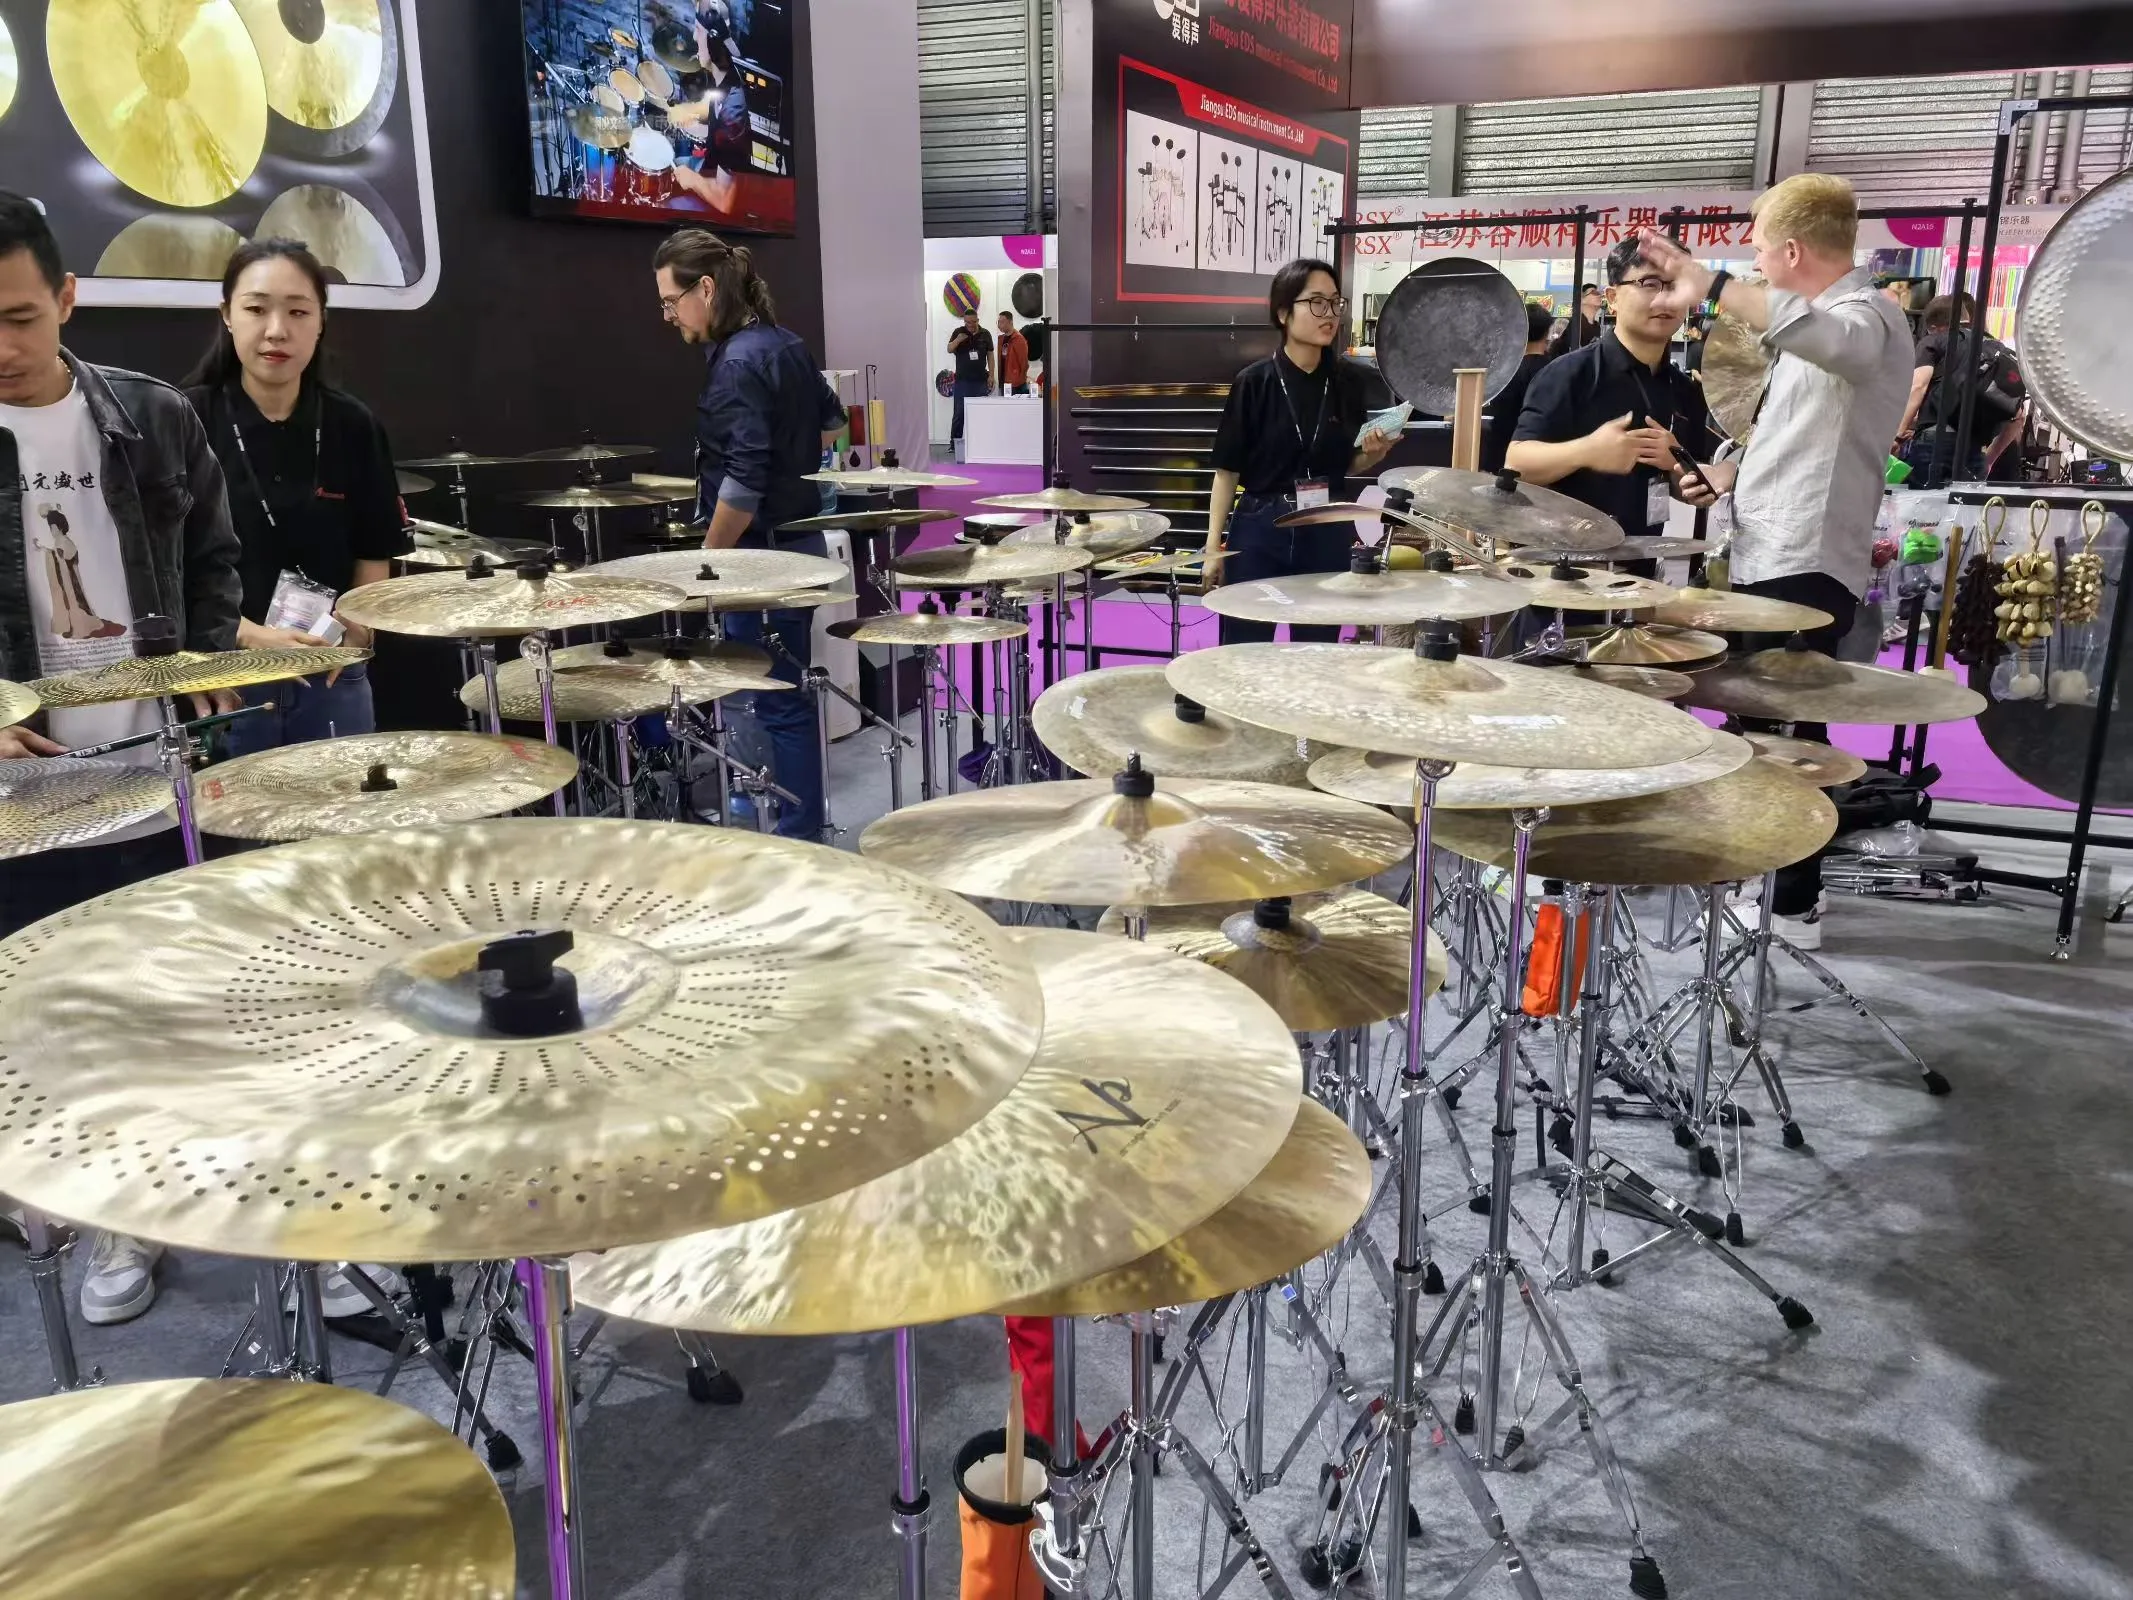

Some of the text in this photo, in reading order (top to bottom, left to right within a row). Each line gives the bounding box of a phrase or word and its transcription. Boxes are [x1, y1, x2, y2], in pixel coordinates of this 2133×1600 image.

[1172, 12, 1200, 46] 爱得声
[1209, 16, 1239, 48] Jiangsu
[1240, 30, 1255, 54] EDS
[1200, 94, 1224, 118] Jiangsu
[1225, 103, 1237, 121] EDS
[1237, 110, 1259, 129] musical
[1259, 115, 1287, 138] instrument
